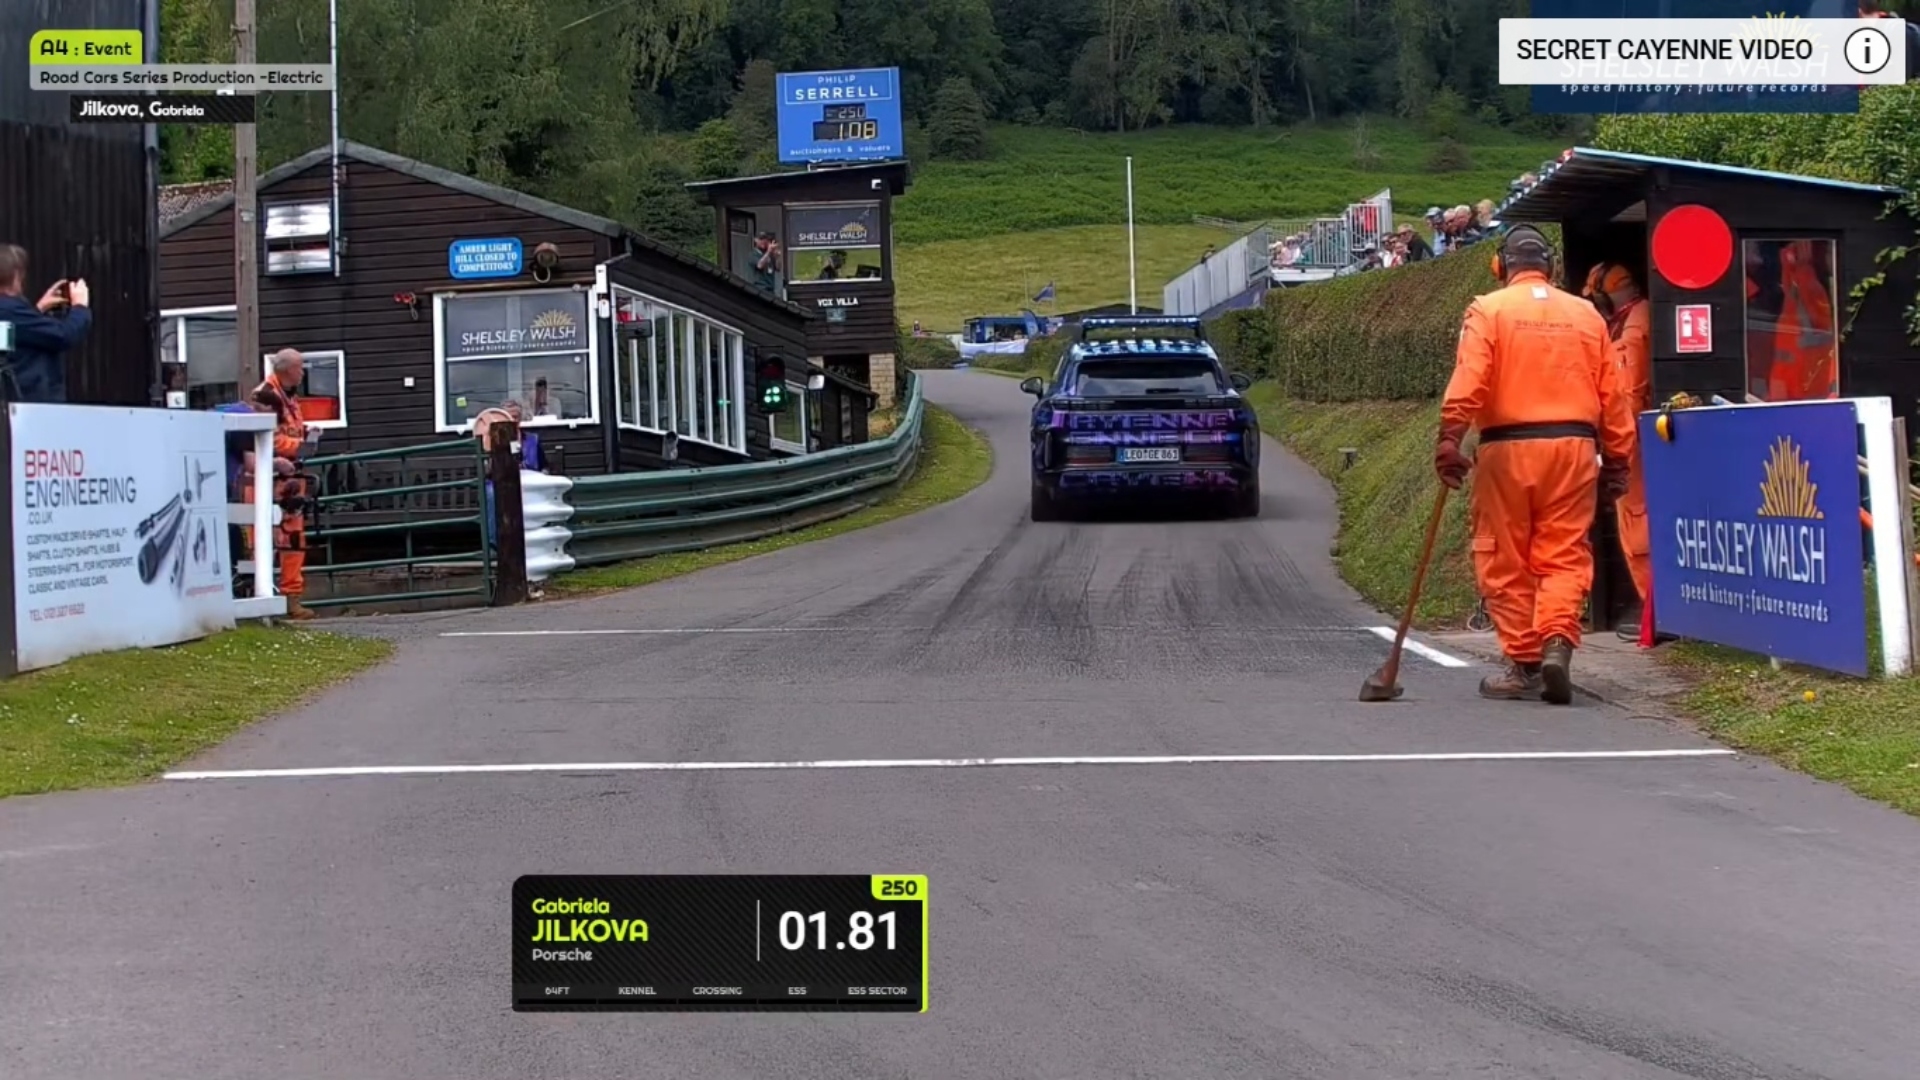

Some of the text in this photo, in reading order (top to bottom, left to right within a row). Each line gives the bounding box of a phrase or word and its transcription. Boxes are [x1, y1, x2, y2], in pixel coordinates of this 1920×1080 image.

[817, 75, 856, 84] PHILIP
[795, 86, 879, 101] SERRELL
[1561, 82, 1611, 95] speed
[1618, 82, 1681, 95] history
[1697, 82, 1753, 96] future
[1760, 82, 1828, 95] records
[790, 145, 891, 156] auctioneers & valuers
[798, 228, 867, 241] SHELSLEY WALSH
[460, 242, 512, 253] AMBER LIGHT
[455, 252, 517, 264] HILL CLOSED TO
[459, 262, 514, 273] COMPETITORS
[817, 297, 858, 307] VOX VILLA
[461, 326, 576, 345] SHELSLEY WALSH
[1125, 449, 1178, 460] LEO GE 861
[25, 449, 84, 478] BRAND
[25, 476, 137, 508] ENGINEERING
[1675, 517, 1826, 584] SHELSLEY WALSH
[1680, 582, 1706, 604] speed
[1709, 582, 1743, 614] history
[1751, 589, 1784, 615] future
[1786, 599, 1829, 622] records
